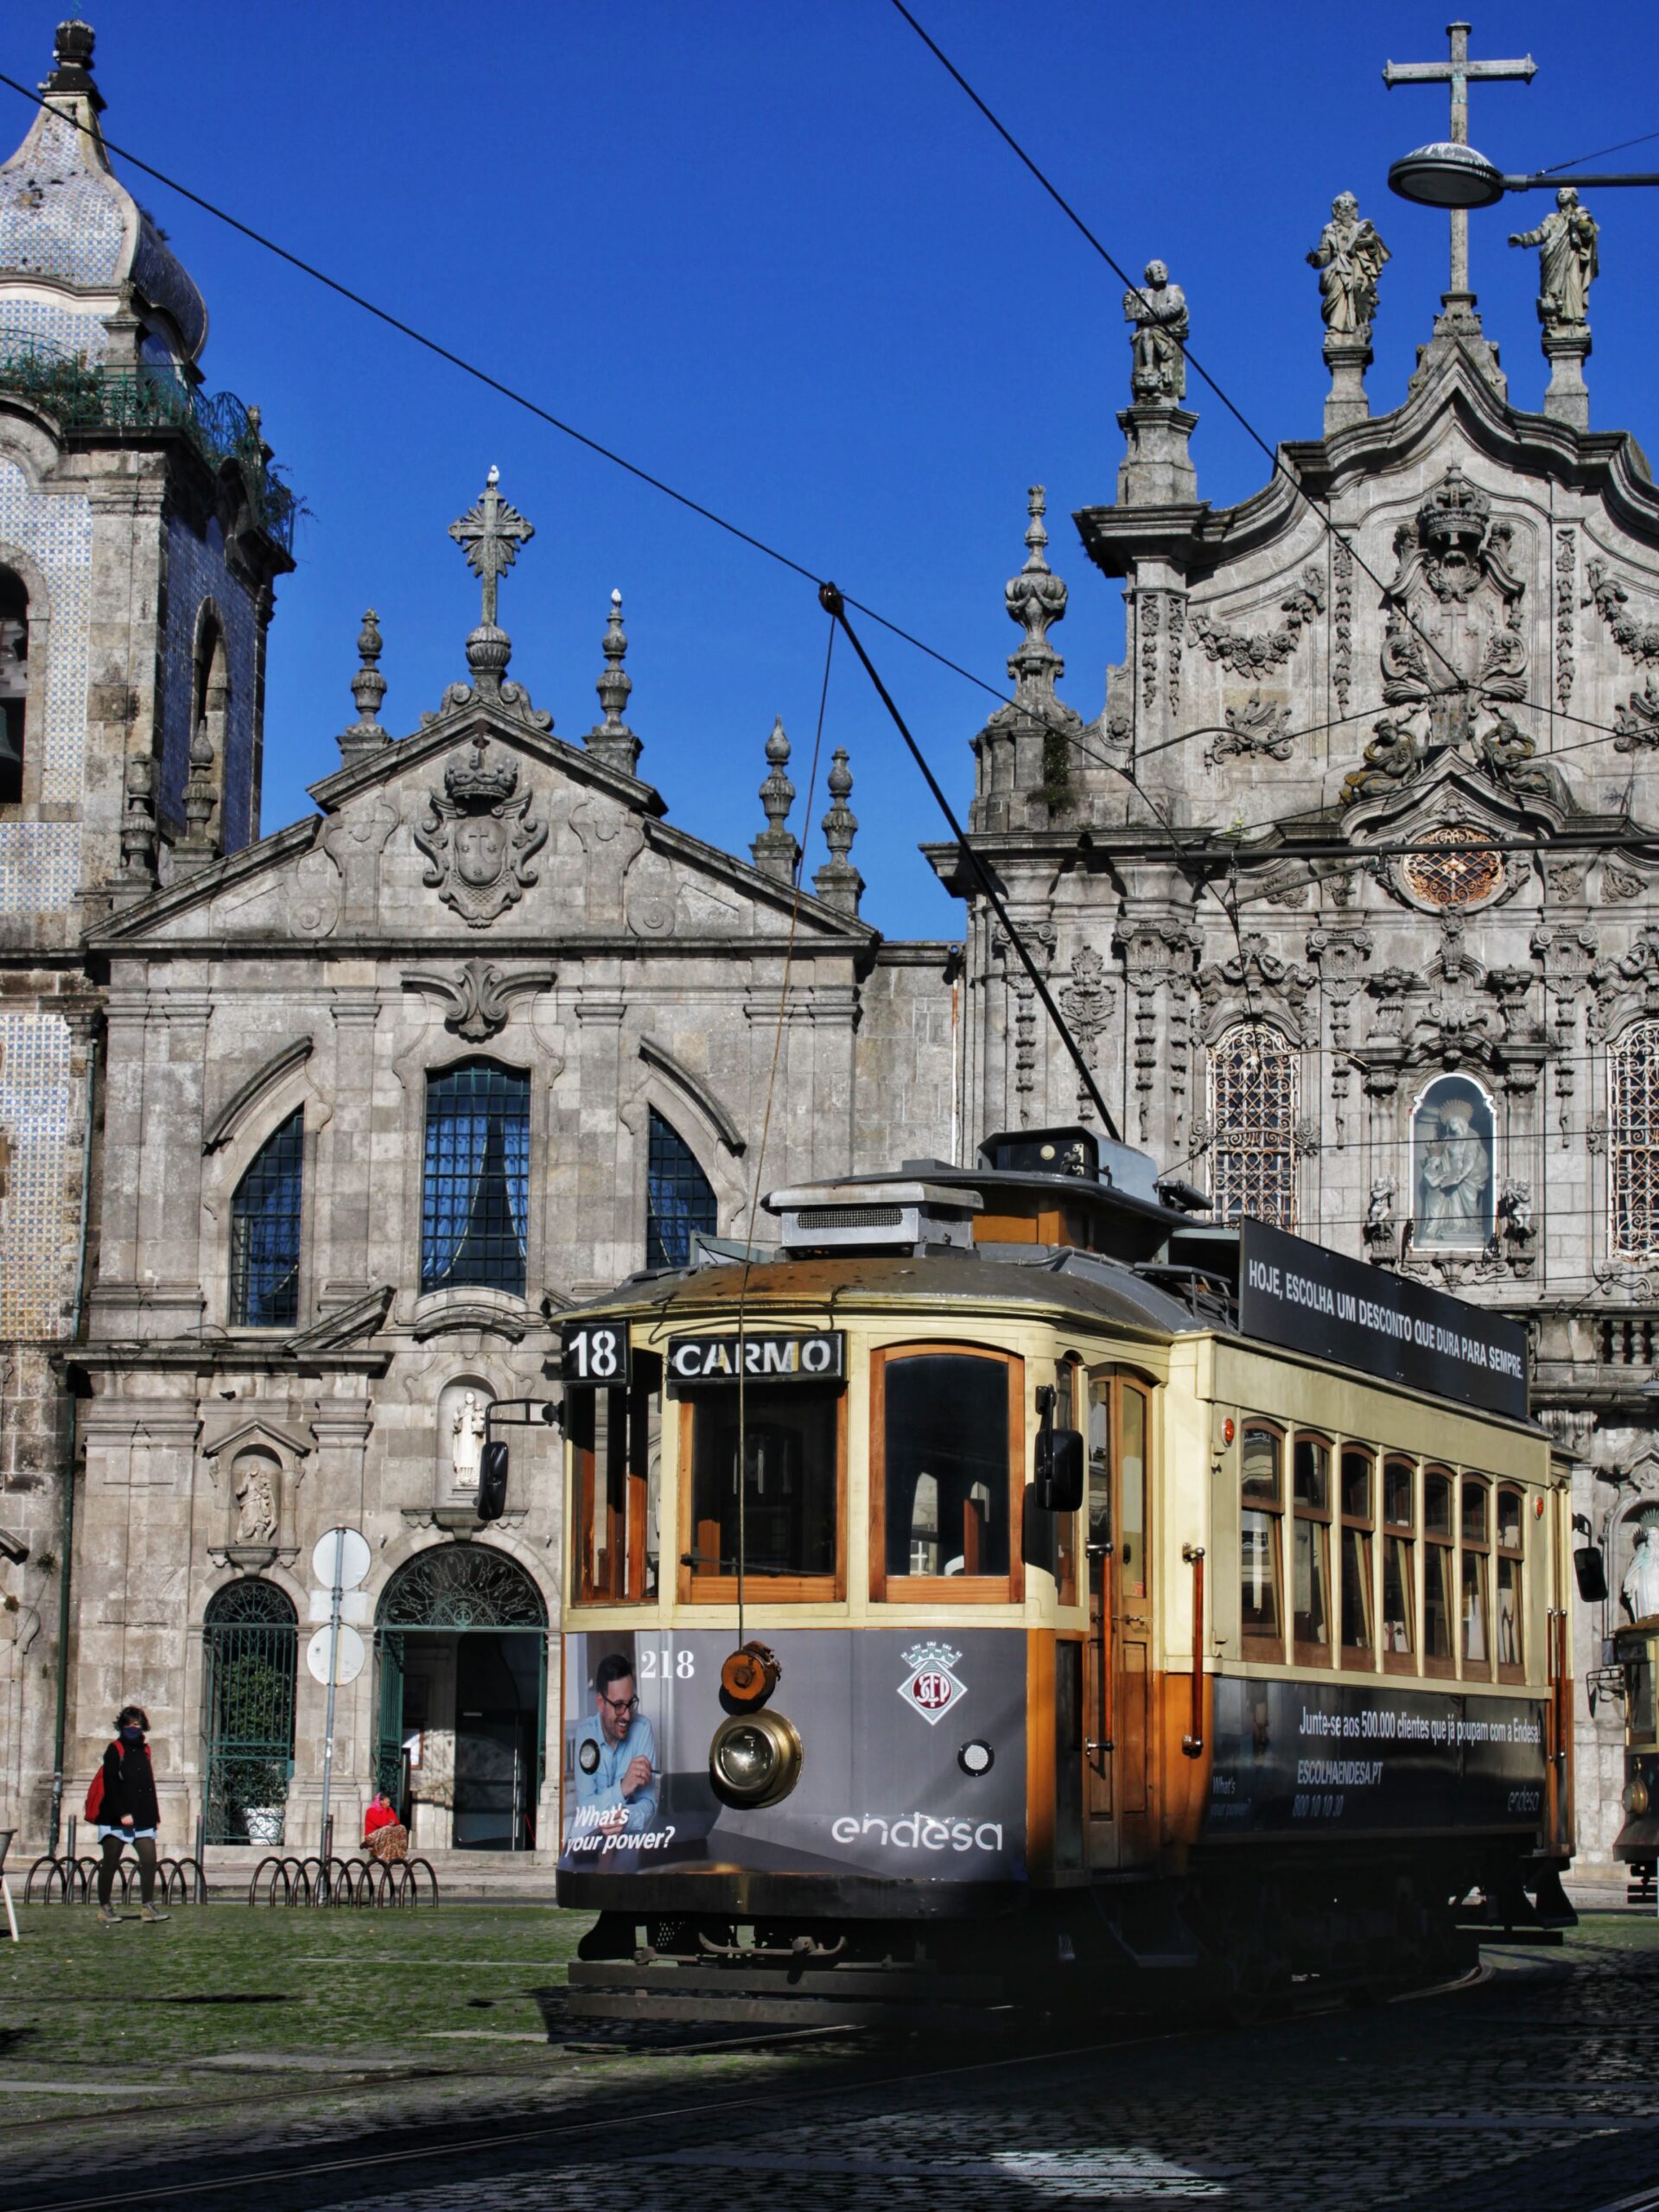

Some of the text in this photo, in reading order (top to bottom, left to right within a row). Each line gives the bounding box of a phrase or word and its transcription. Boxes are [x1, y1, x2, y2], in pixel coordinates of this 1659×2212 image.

[1249, 1259, 1523, 1380] HOJE, ESCOLHA UM DESCONTO QUE DURA PARA SEMPRE.
[569, 1330, 617, 1377] 18
[676, 1339, 830, 1376] CARMO
[640, 1650, 695, 1679] 218
[1300, 1706, 1541, 1747] Junte-se aos 500.000 clientes que já poupam com a Endesa!
[1297, 1759, 1383, 1784] ESCOLHAENDESA.PT
[575, 1802, 630, 1827] What's
[831, 1811, 1003, 1851] endesa
[565, 1826, 676, 1858] your power?
